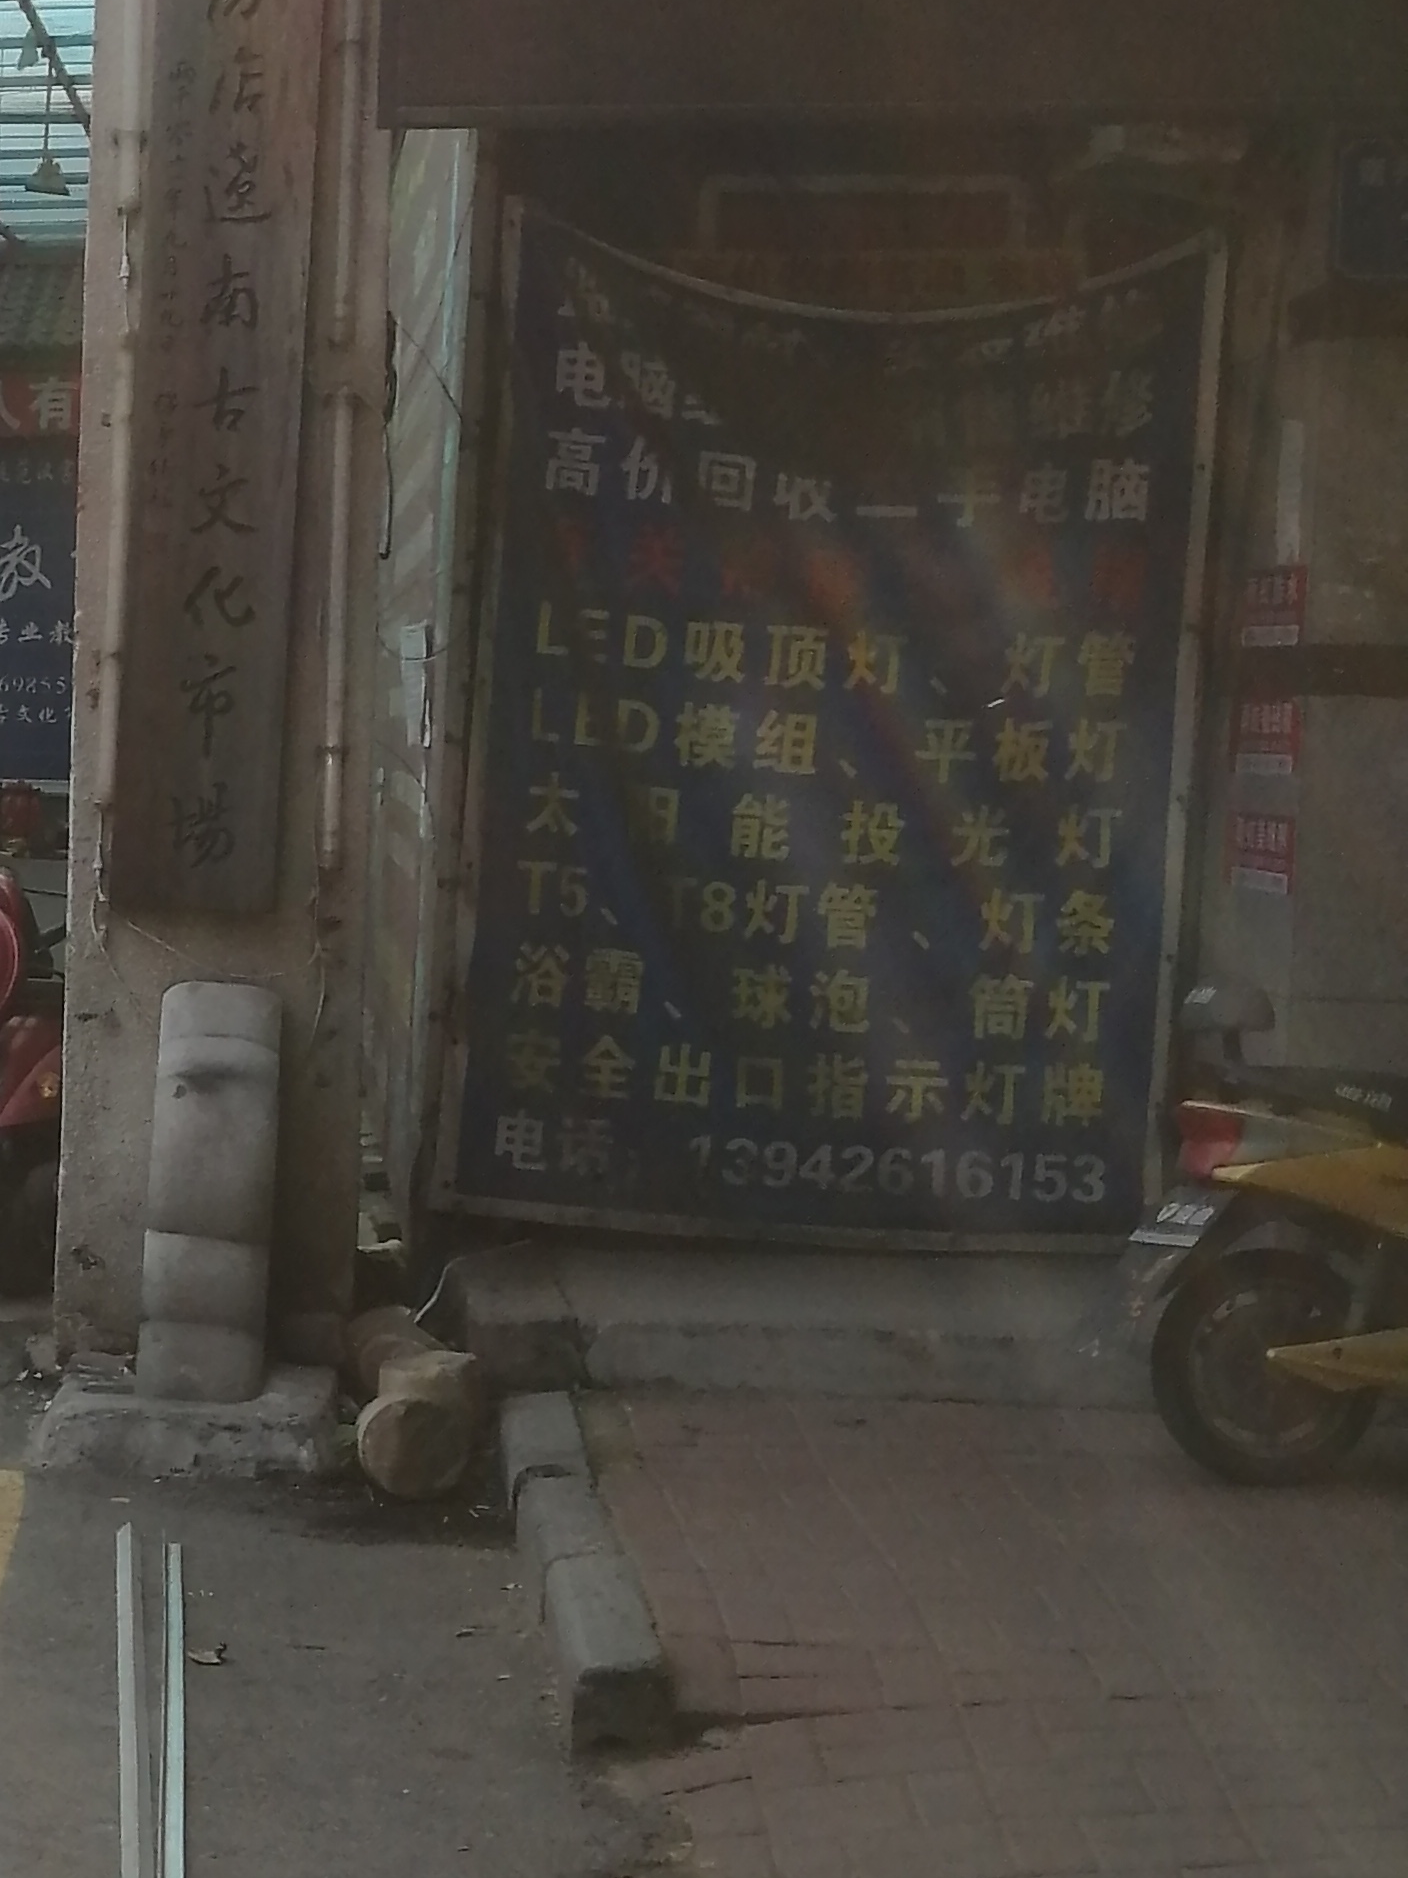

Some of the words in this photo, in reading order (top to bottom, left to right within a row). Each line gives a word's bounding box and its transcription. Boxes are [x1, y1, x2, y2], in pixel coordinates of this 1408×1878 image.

[505, 1033, 1106, 1126] 安全出口指示灯牌
